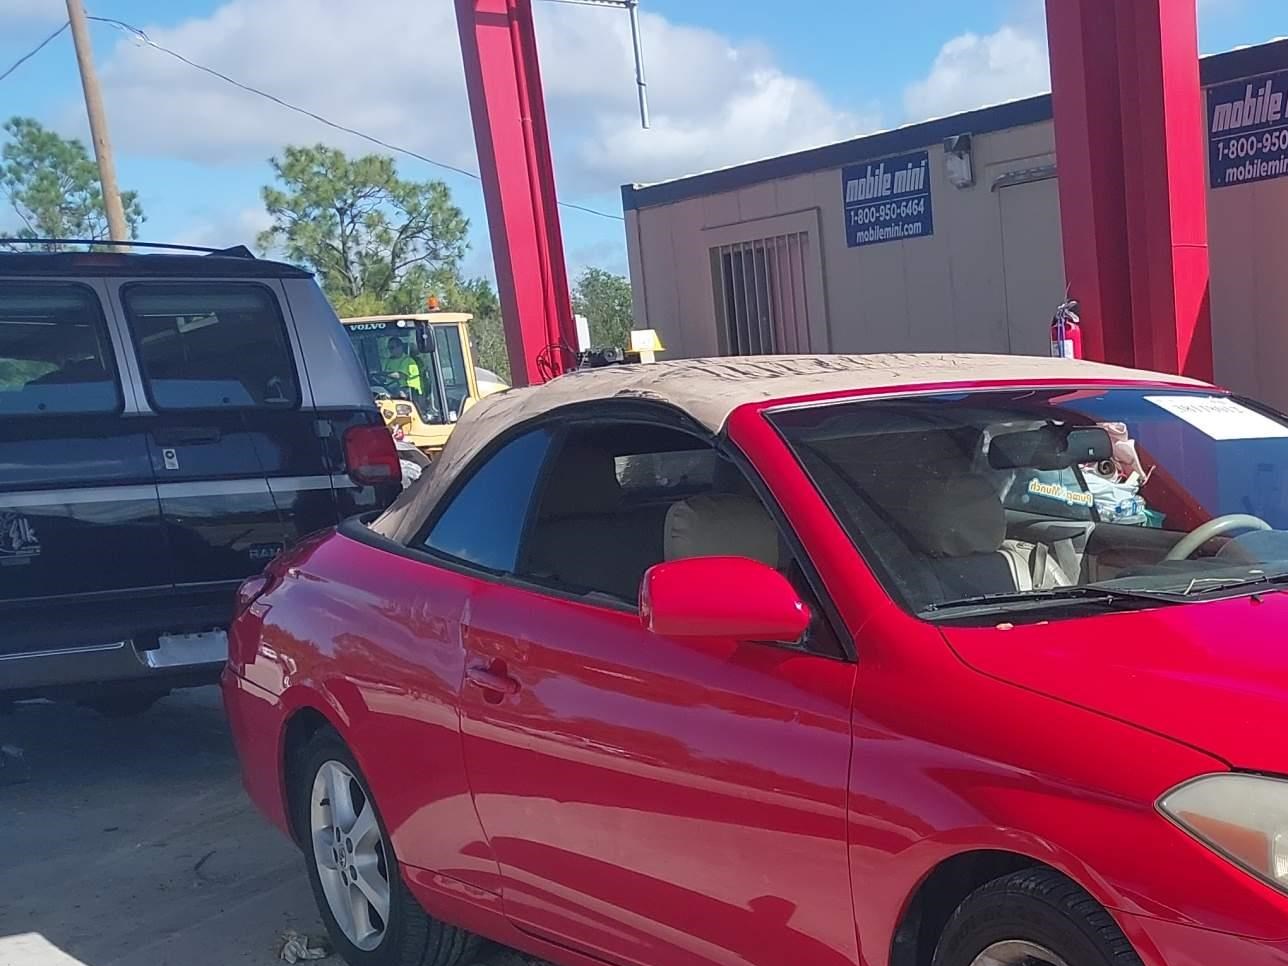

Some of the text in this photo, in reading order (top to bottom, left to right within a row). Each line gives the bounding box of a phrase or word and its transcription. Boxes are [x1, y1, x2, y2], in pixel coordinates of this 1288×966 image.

[1212, 80, 1283, 133] mobile
[846, 160, 926, 202] mobile mini
[851, 198, 924, 226] 1-800-950-6464
[856, 221, 922, 243] mobilemini.com
[350, 322, 386, 331] VOLVO
